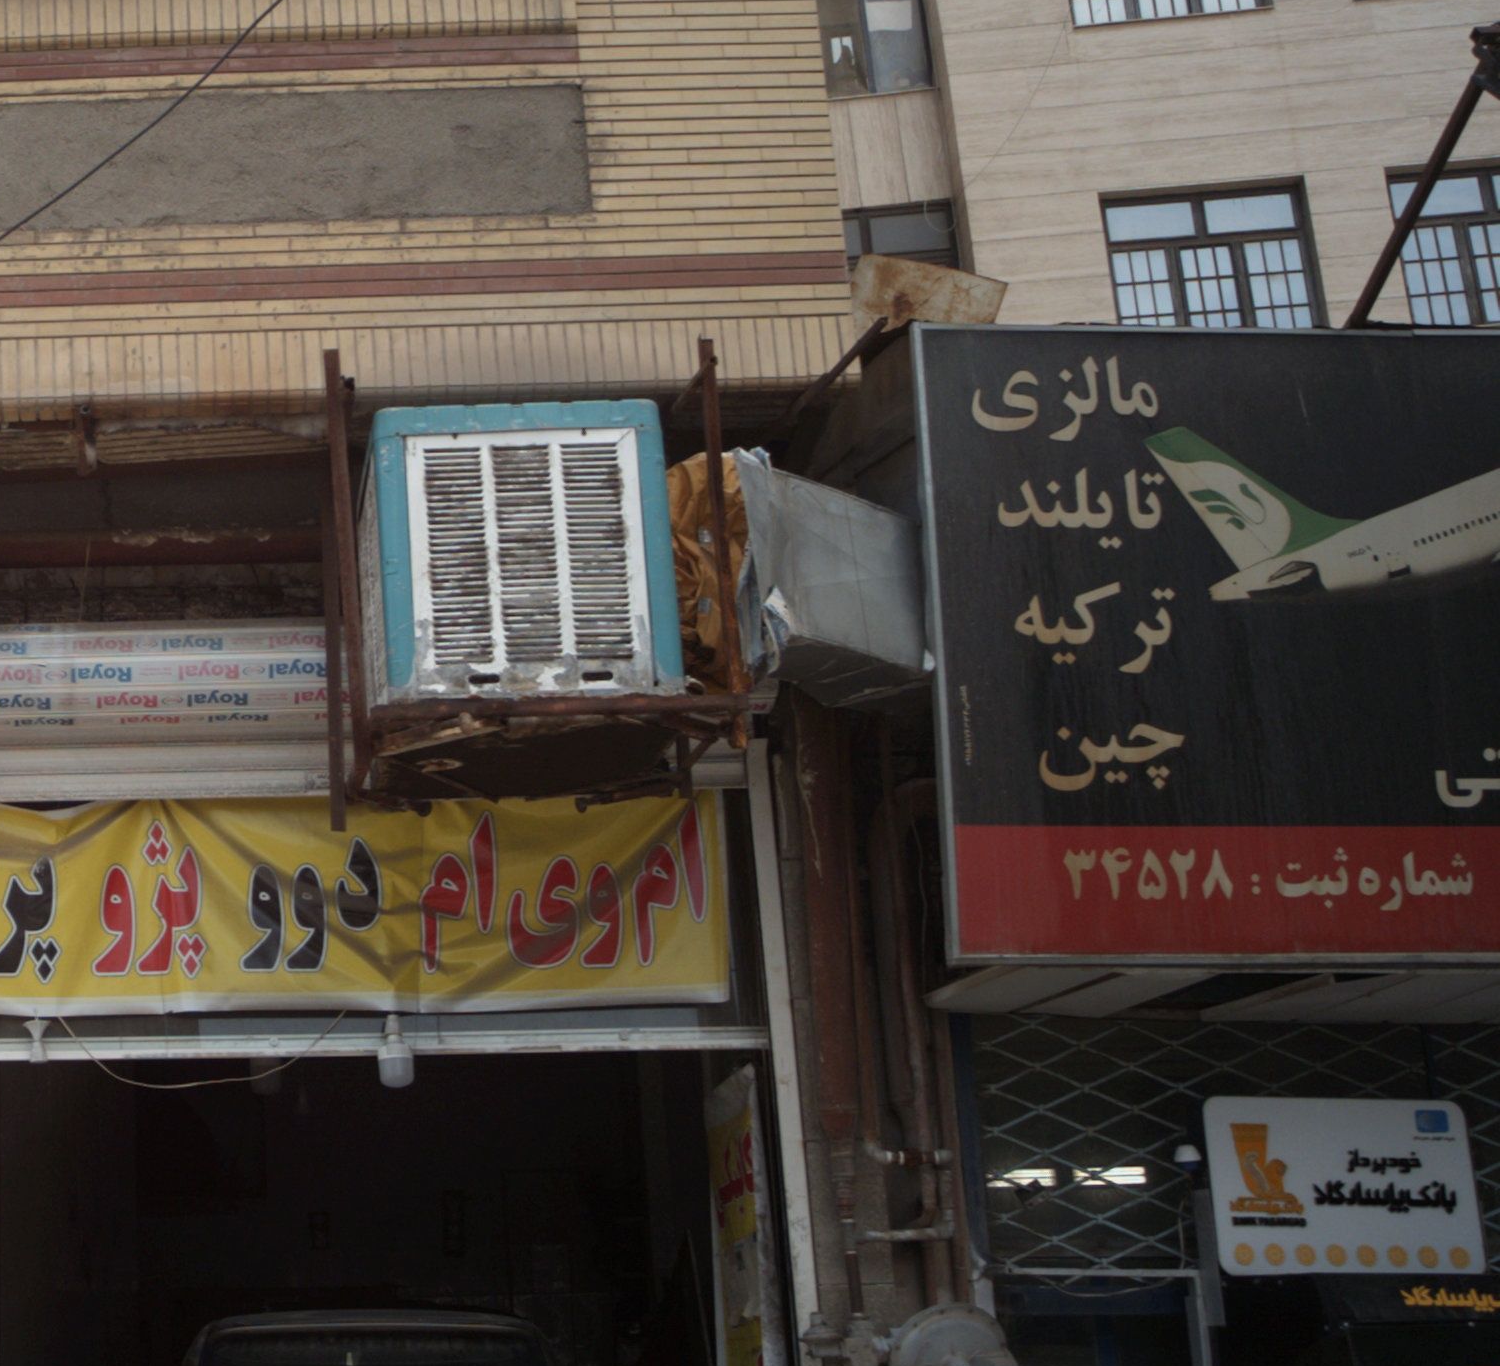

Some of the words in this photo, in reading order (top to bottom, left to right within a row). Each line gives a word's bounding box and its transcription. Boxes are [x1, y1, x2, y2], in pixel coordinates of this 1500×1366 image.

[972, 355, 1159, 442] مالزی
[997, 468, 1166, 549] تایلند
[162, 637, 223, 651] Royal
[1013, 582, 1175, 674] ترکیه
[71, 663, 132, 684] Royal
[178, 662, 240, 681] Royal
[187, 690, 248, 706] Royal
[269, 659, 327, 679] Royal
[294, 687, 354, 705] Ryal
[96, 694, 158, 708] Royal
[1038, 720, 1186, 791] چین
[93, 818, 204, 980] پژو
[419, 810, 495, 972] ام
[632, 806, 708, 967] ام
[1063, 846, 1235, 902] ۳۴۵۲۸
[1357, 852, 1474, 912] شماره
[240, 837, 382, 973] دوو
[506, 854, 624, 970] وی
[1346, 1148, 1422, 1175] خودپرداز
[1405, 1180, 1457, 1214] بانک
